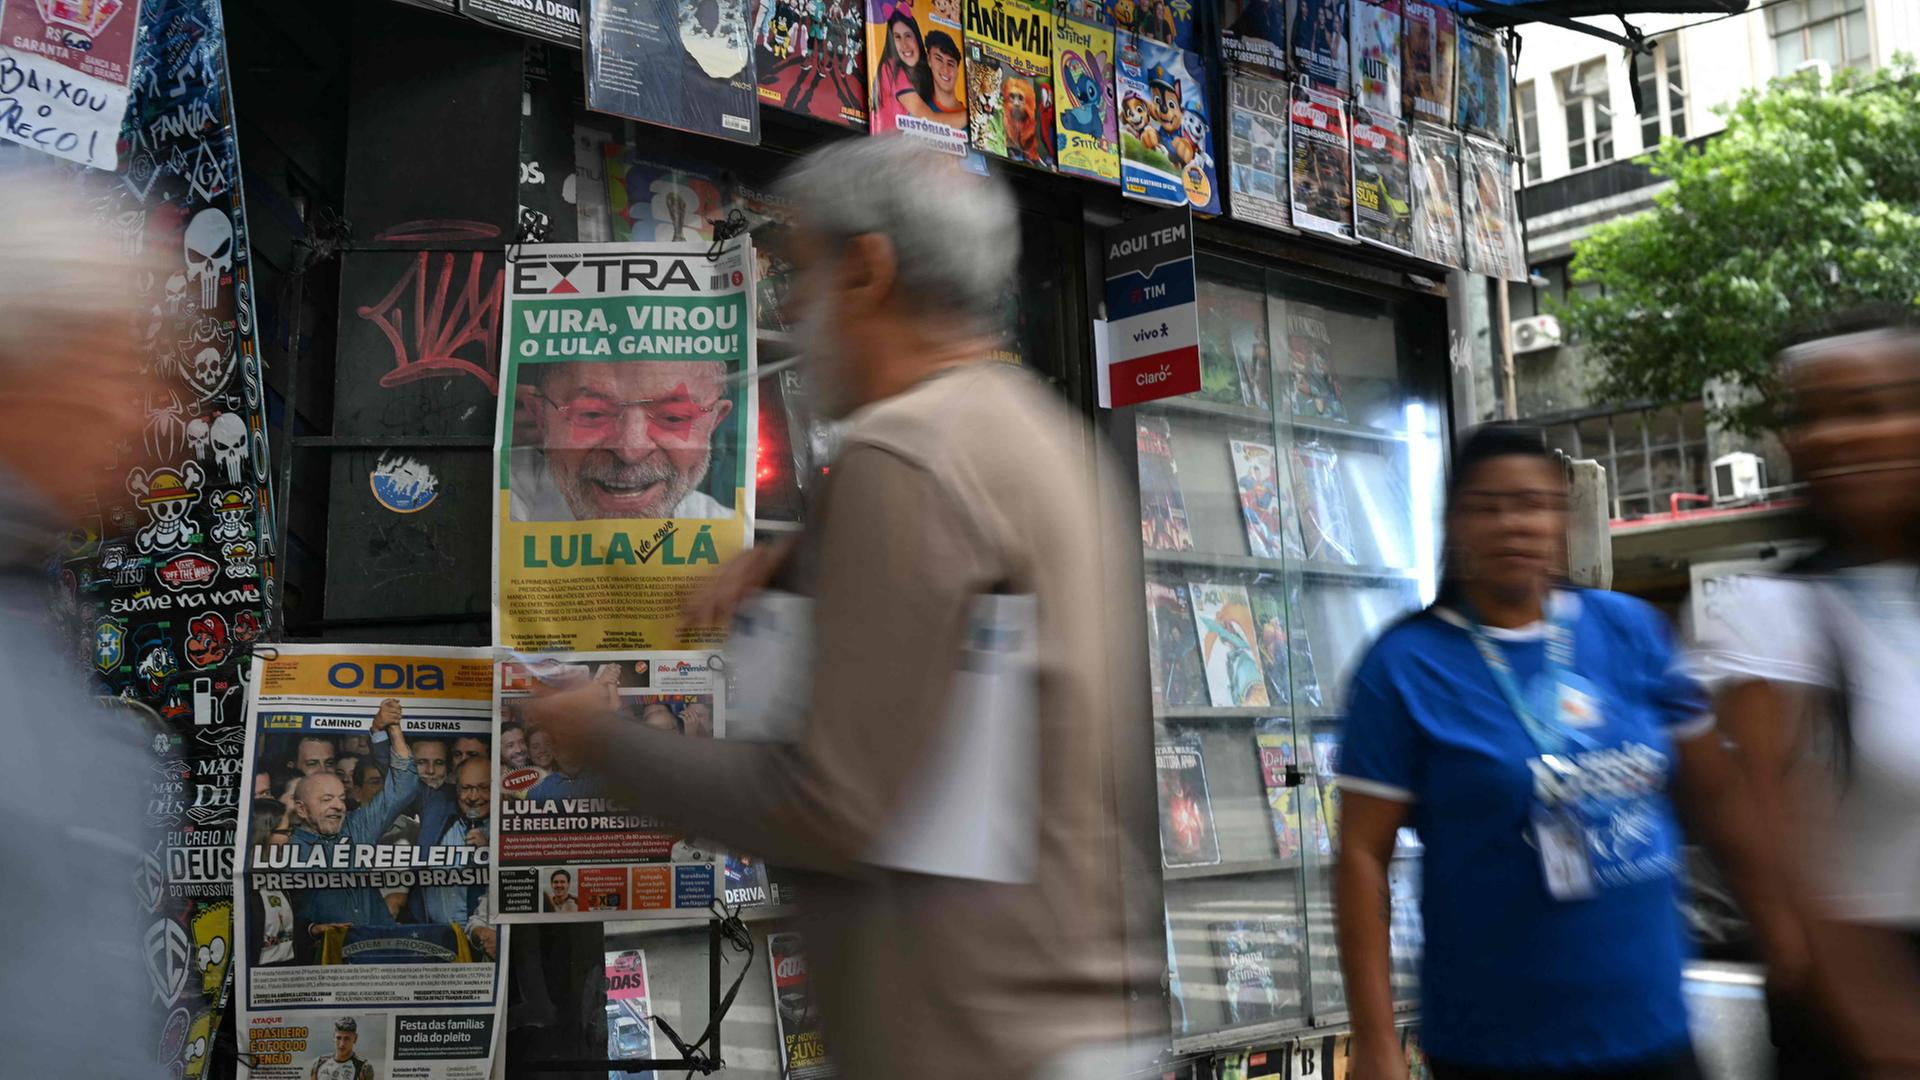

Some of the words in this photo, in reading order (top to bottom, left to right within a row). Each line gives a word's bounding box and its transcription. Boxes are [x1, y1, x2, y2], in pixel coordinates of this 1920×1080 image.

[986, 47, 1012, 63] Biomas
[1014, 57, 1023, 67] do
[1026, 60, 1049, 75] Brasil
[0, 57, 106, 112] BAIXOU
[898, 117, 951, 137] HISTÓRIAS
[1109, 234, 1148, 260] AQUI
[1151, 223, 1186, 247] TEM
[513, 258, 701, 295] EXTRA
[1144, 283, 1166, 300] TIM
[523, 308, 617, 335] VIRA,
[626, 304, 738, 331] VIROU
[1133, 330, 1159, 342] vivo
[519, 338, 539, 357] O
[546, 337, 611, 357] LULA
[618, 334, 739, 354] GANHOU!
[1136, 370, 1167, 386] Claro
[523, 533, 637, 568] LULA
[661, 525, 720, 566] LÁ
[114, 569, 144, 586] JITSU
[180, 568, 195, 579] THE
[111, 594, 171, 613] suave
[176, 592, 206, 608] na
[210, 589, 260, 606] nave
[328, 662, 364, 689] O
[657, 664, 671, 672] Rio
[314, 718, 362, 727] CAMINHO
[407, 721, 426, 730] DAS
[428, 721, 461, 731] URNAS
[216, 744, 240, 756] NAS
[216, 775, 234, 787] DE
[510, 772, 538, 785] TETRA!
[502, 799, 558, 815] LULA
[562, 798, 628, 814] VENC
[502, 818, 510, 830] E
[513, 815, 521, 830] É
[524, 817, 589, 831] REELEITO
[591, 816, 672, 830] PRESIDEN
[167, 831, 182, 846] EU
[185, 830, 221, 845] CREIO
[225, 830, 237, 844] N
[253, 844, 327, 869] LULA
[333, 837, 350, 869] É
[355, 844, 490, 869] REELEITO
[170, 848, 235, 880] DEUS
[253, 871, 384, 890] PRESIDENTE
[386, 871, 416, 888] DO
[419, 870, 490, 887] BRASIL
[169, 885, 181, 897] DO
[725, 886, 766, 904] DERIVA
[1229, 951, 1263, 966] Ragna
[1227, 966, 1271, 981] Crimson
[252, 1017, 283, 1025] ATAQUE
[400, 1020, 427, 1030] Festa
[429, 1019, 446, 1030] das
[447, 1018, 485, 1030] famílias
[249, 1026, 309, 1040] BRASILEIRO
[400, 1034, 412, 1043] no
[413, 1032, 428, 1042] dia
[430, 1032, 442, 1042] do
[443, 1031, 471, 1044] pleito
[258, 1041, 266, 1051] O
[292, 1040, 306, 1051] DO
[1301, 1048, 1315, 1076] B
